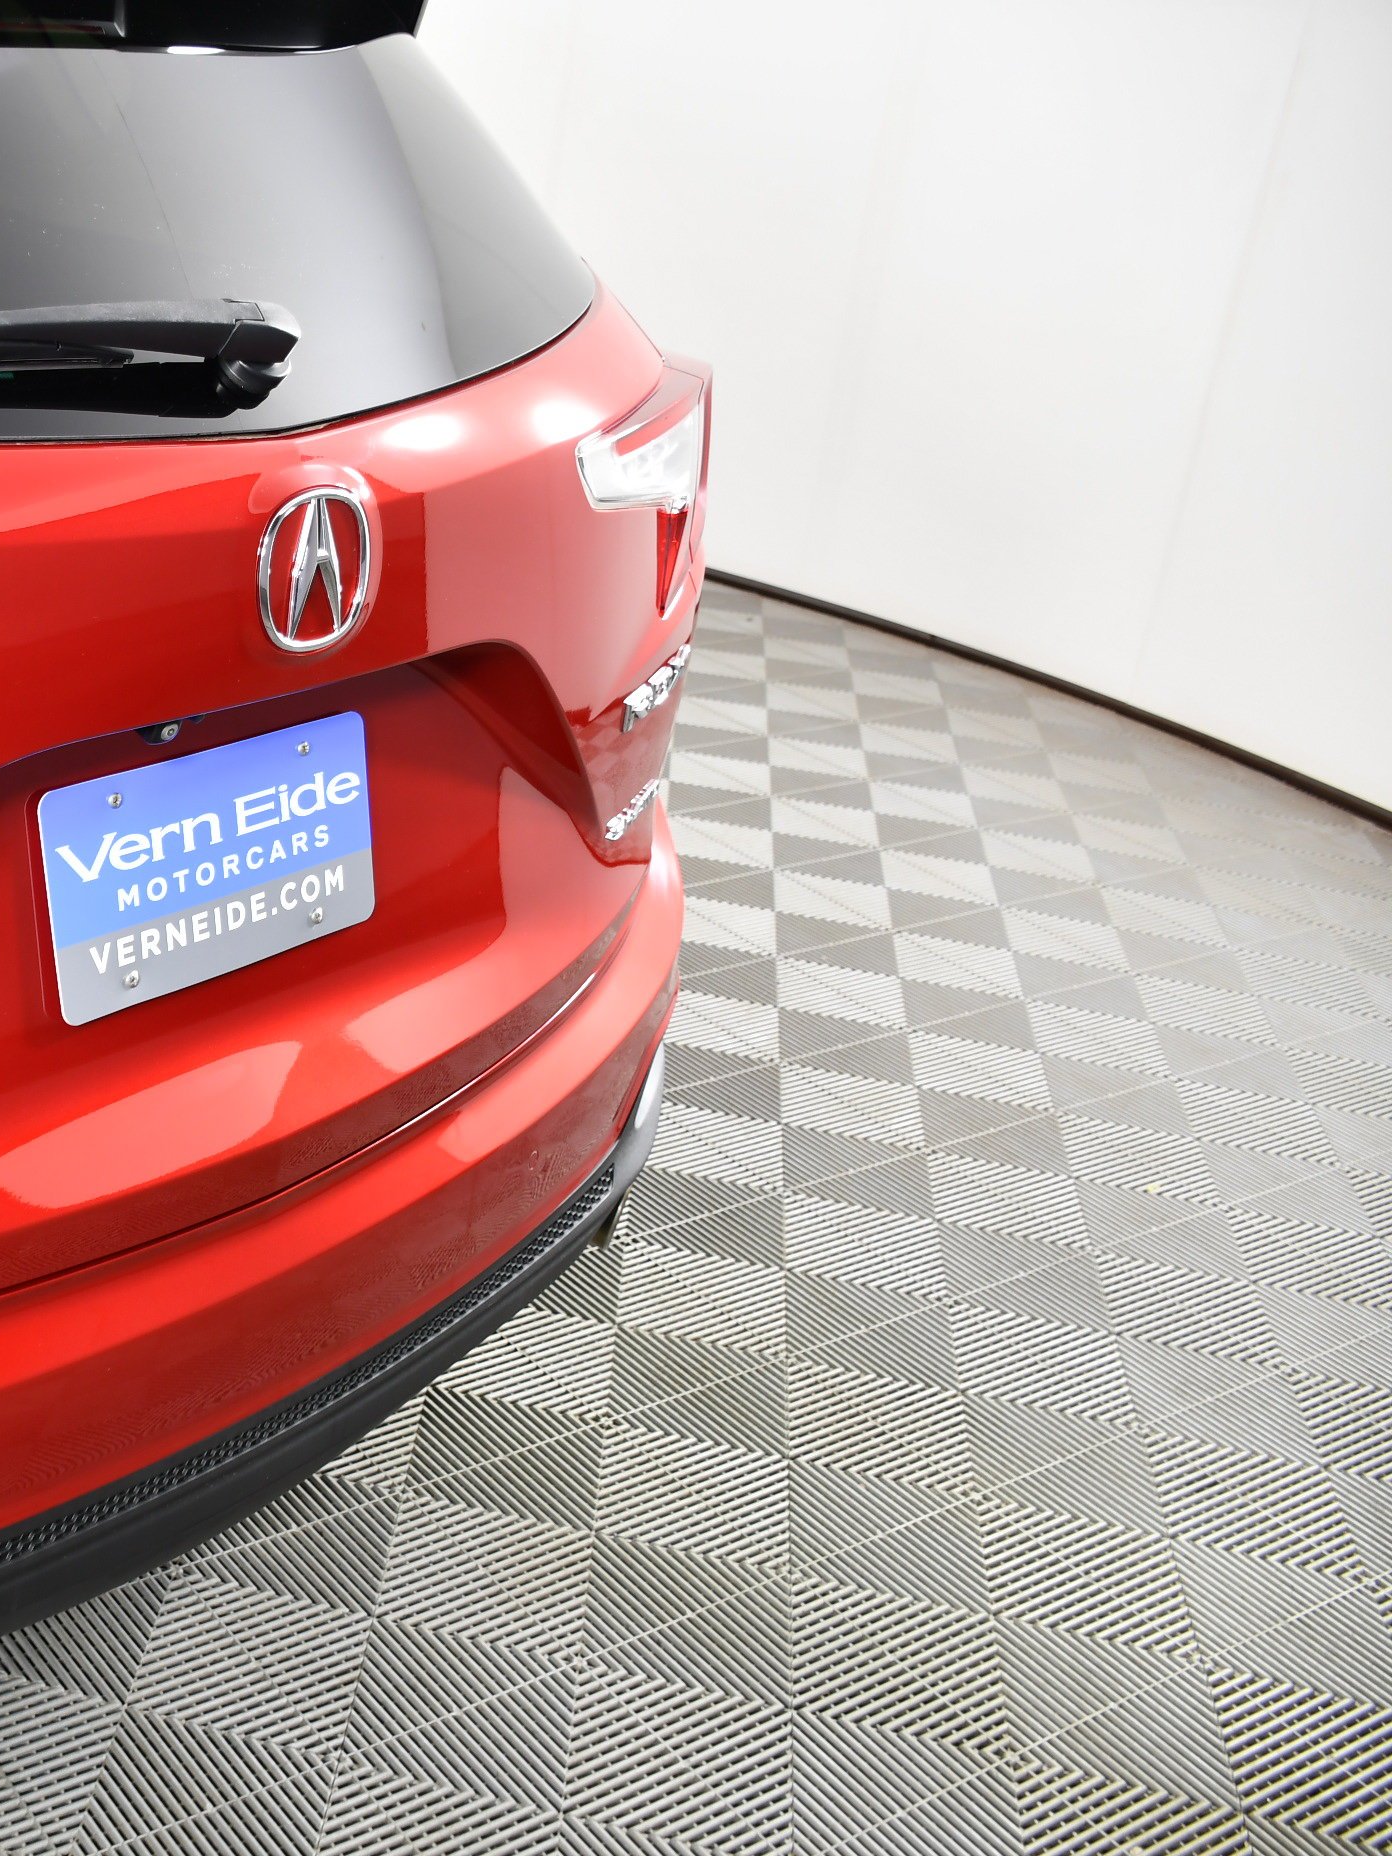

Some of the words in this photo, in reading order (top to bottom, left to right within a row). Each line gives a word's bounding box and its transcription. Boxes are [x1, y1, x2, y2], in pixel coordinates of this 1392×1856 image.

[55, 811, 223, 883] Vern
[233, 771, 361, 837] Eide
[116, 824, 330, 912] MOTORCARS
[88, 864, 345, 976] VERNEIDE.COM
